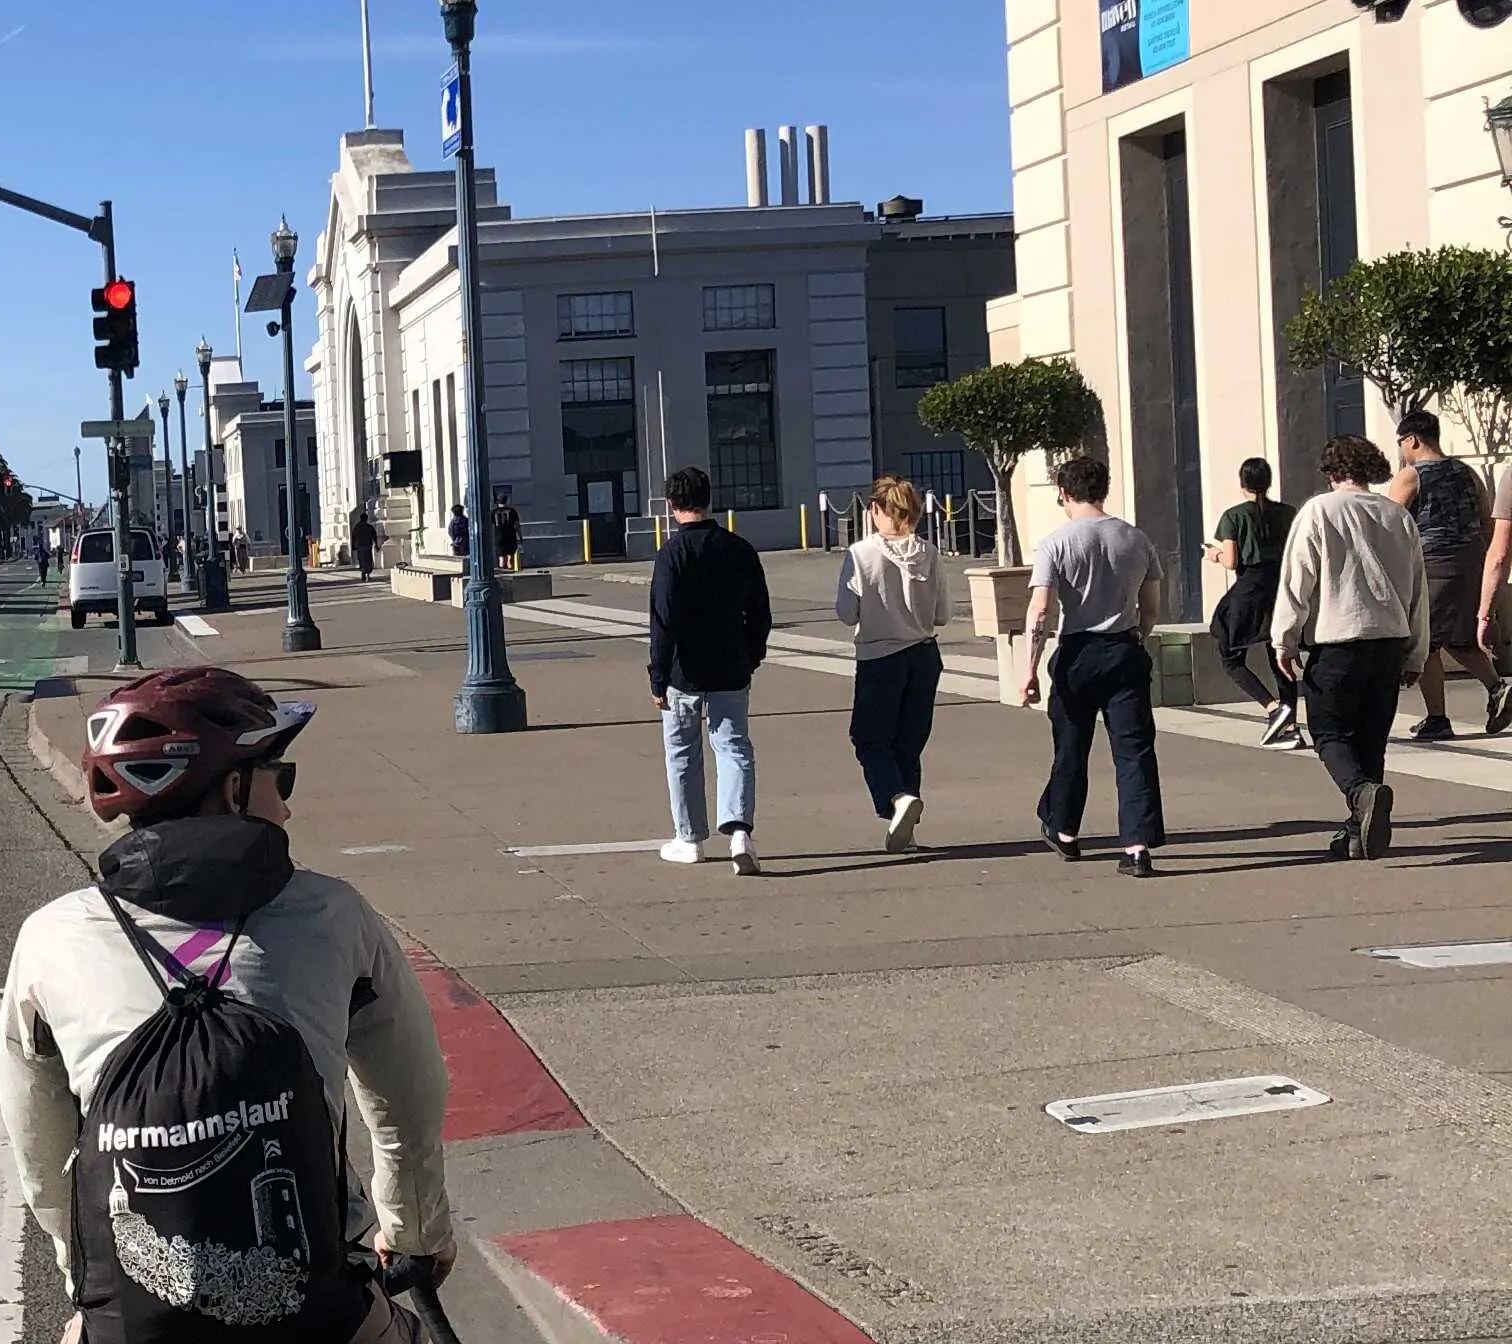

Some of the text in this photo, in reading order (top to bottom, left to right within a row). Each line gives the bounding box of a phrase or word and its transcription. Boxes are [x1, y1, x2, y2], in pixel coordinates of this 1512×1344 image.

[98, 1092, 289, 1152] Hermannslauf
[143, 1176, 159, 1185] von
[160, 1171, 194, 1185] Detmold
[195, 1160, 214, 1175] nach
